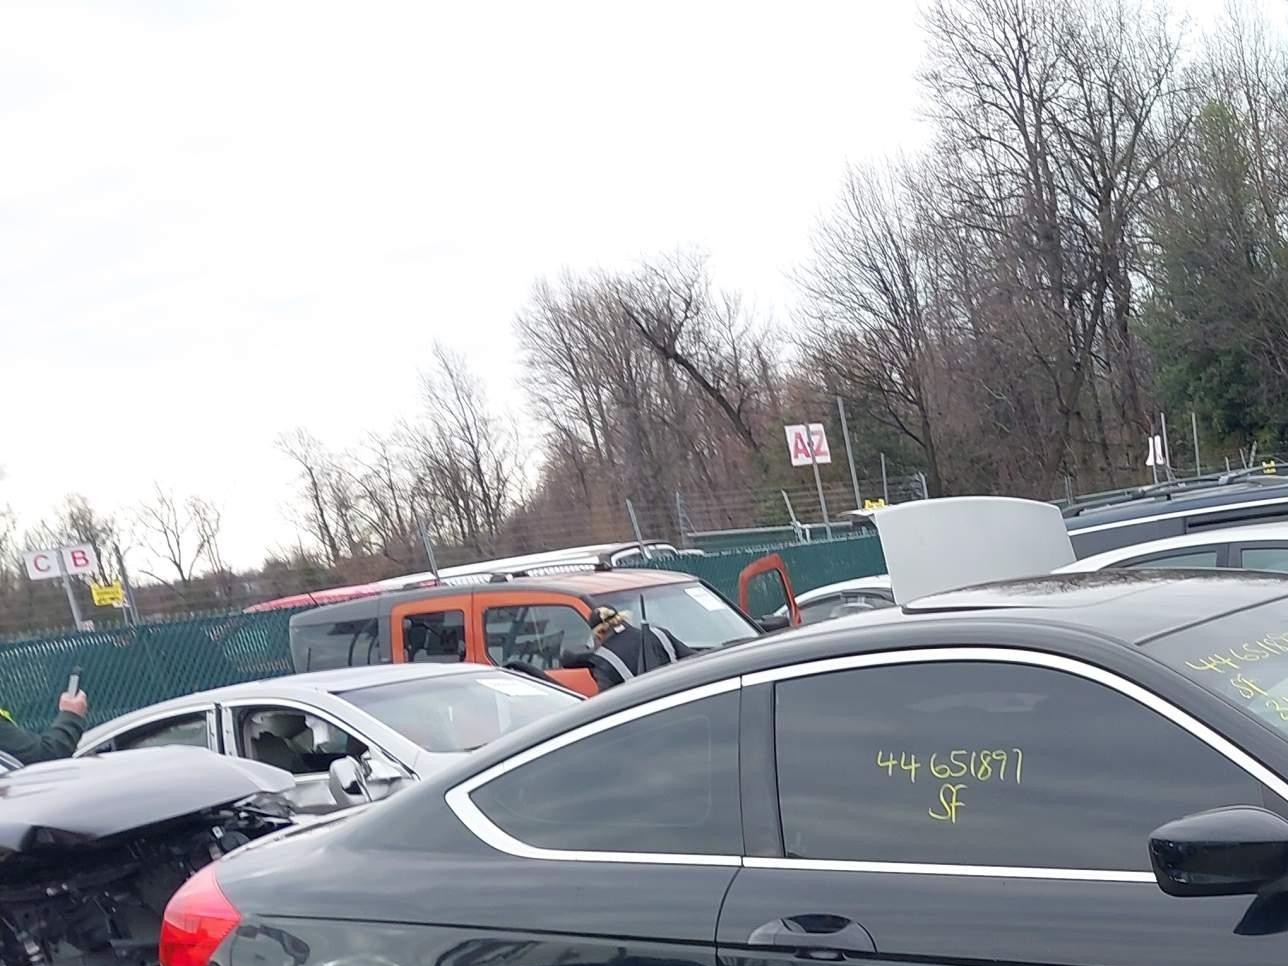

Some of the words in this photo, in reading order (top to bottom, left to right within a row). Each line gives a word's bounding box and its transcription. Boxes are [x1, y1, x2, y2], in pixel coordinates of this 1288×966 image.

[33, 554, 51, 572] C
[71, 550, 89, 568] B
[928, 783, 969, 824] SF
